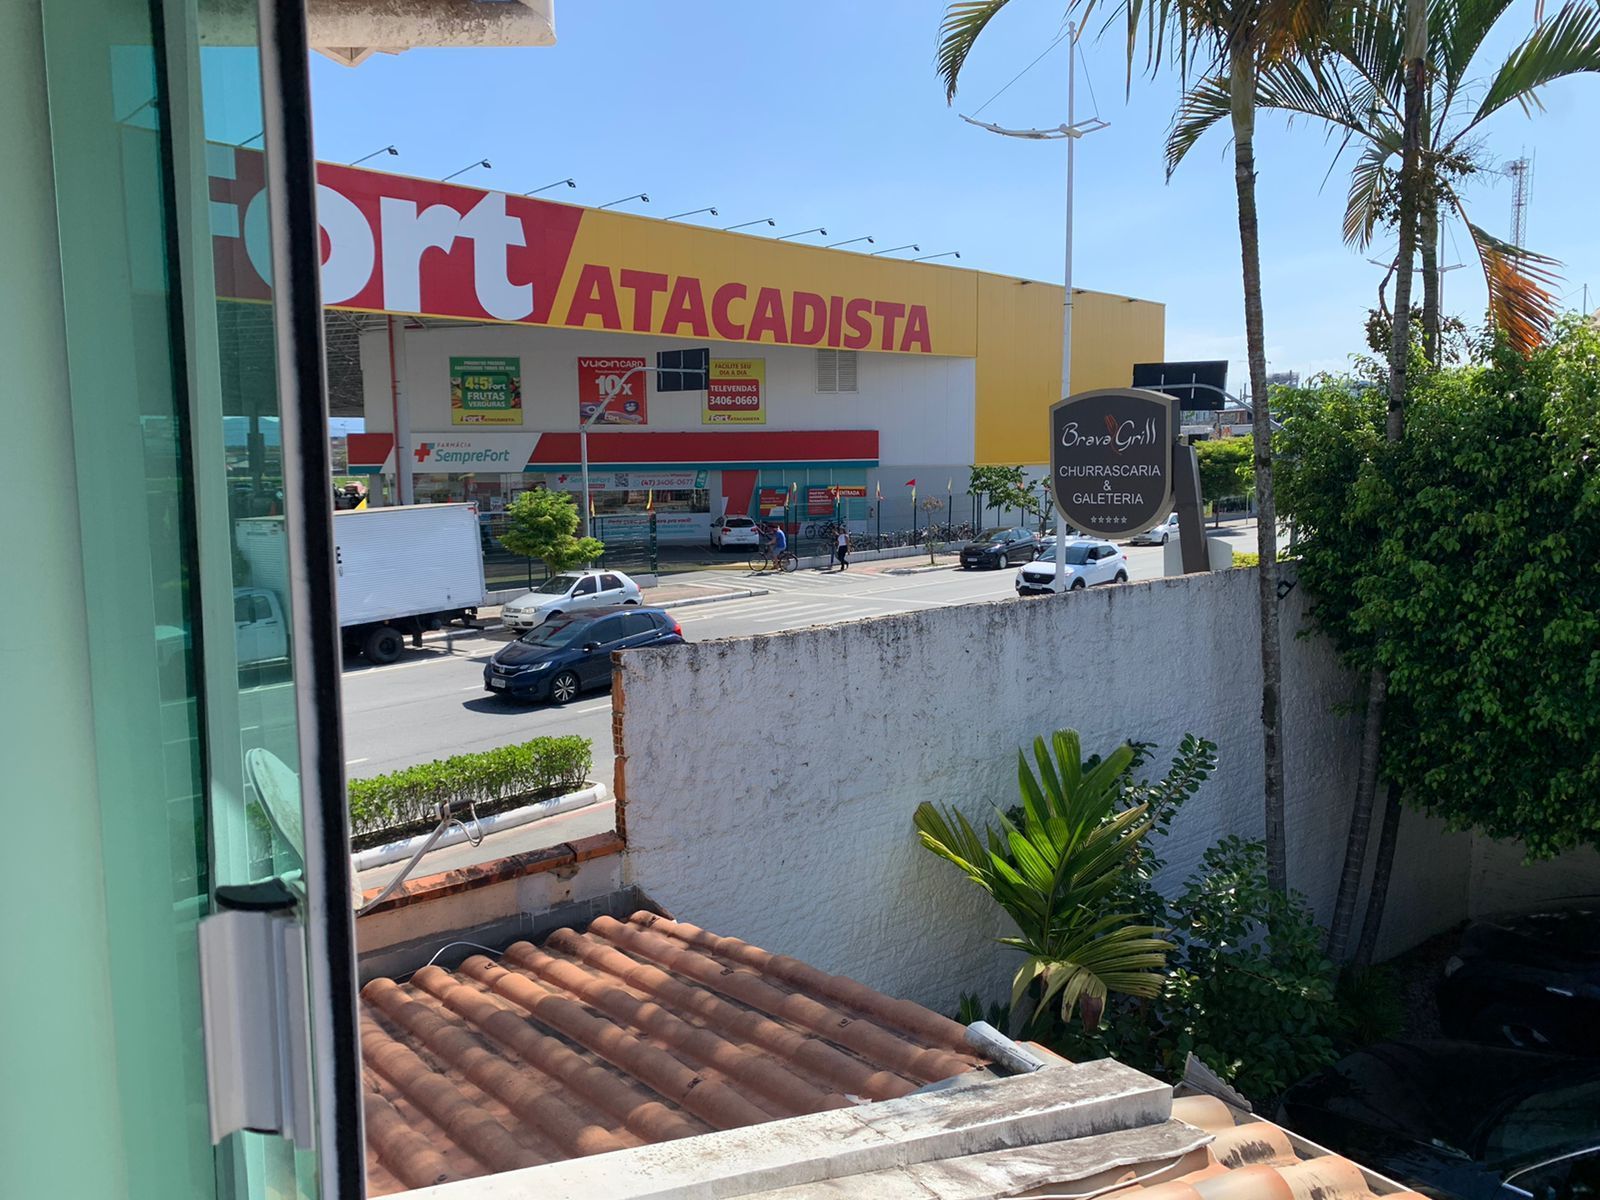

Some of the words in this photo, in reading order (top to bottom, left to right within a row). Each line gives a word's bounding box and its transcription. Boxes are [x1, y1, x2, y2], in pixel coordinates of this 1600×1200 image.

[565, 264, 932, 354] ATACADISTA
[467, 392, 505, 400] FRUTAS
[709, 396, 758, 405] 3406-0669
[1062, 421, 1111, 446] Brava
[1115, 418, 1156, 452] Grill
[435, 449, 510, 464] SempreFort
[1059, 465, 1161, 477] CHURRASCARIA
[1103, 480, 1112, 491] &
[1073, 493, 1144, 505] GALETERIA
